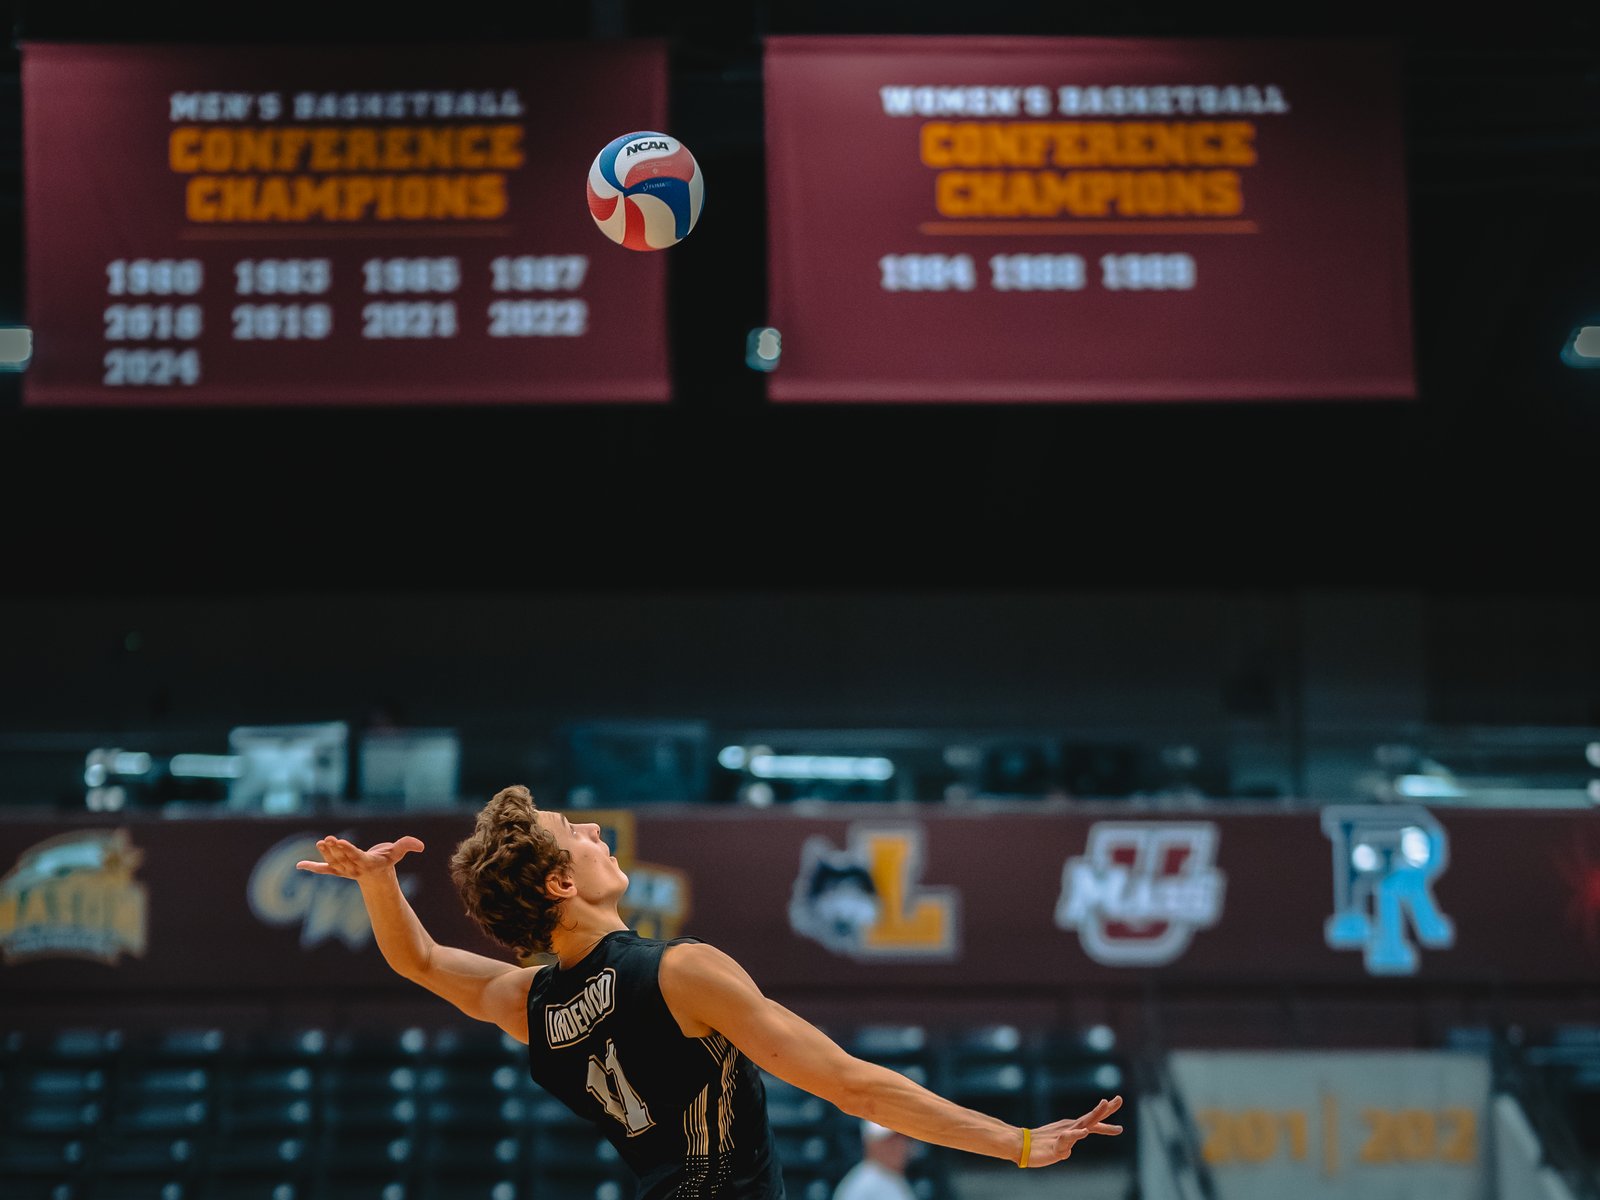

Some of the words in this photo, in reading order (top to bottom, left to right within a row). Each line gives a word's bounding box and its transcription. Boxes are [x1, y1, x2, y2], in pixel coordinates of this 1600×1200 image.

[170, 92, 281, 120] MEN'S
[294, 91, 523, 118] BASKETBALL
[880, 86, 1052, 116] WOMEN'S
[1057, 85, 1289, 115] BASKETBALL
[170, 126, 524, 172] CONFERENCE
[626, 141, 669, 156] NCAA
[920, 121, 1257, 167] CONFERENCE
[186, 174, 508, 222] CHAMPIONS
[936, 170, 1243, 217] CHAMPIONS
[586, 1039, 655, 1136] 11
